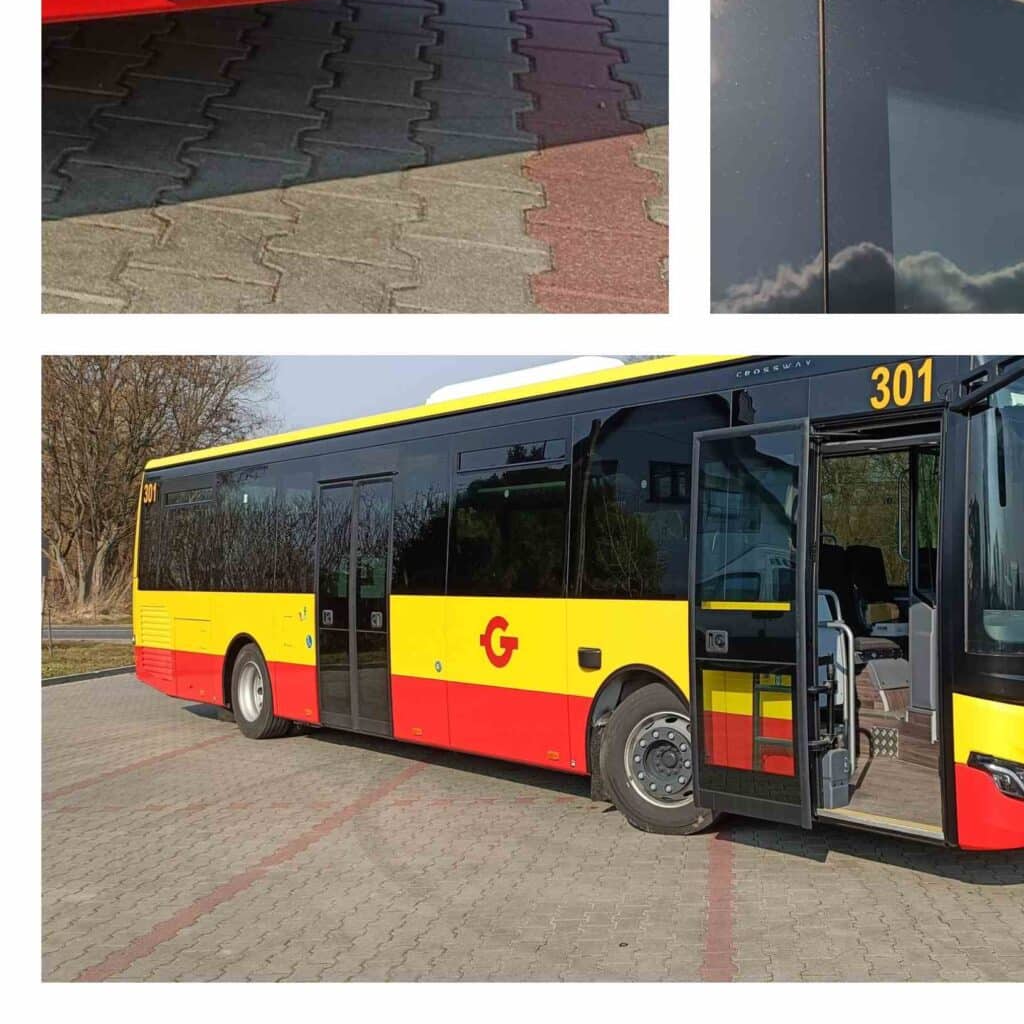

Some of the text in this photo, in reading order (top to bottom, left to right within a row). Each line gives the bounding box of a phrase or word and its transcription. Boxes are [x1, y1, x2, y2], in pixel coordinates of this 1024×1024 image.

[736, 359, 811, 378] CROSSWAY
[870, 357, 933, 410] 301
[144, 482, 156, 503] 301
